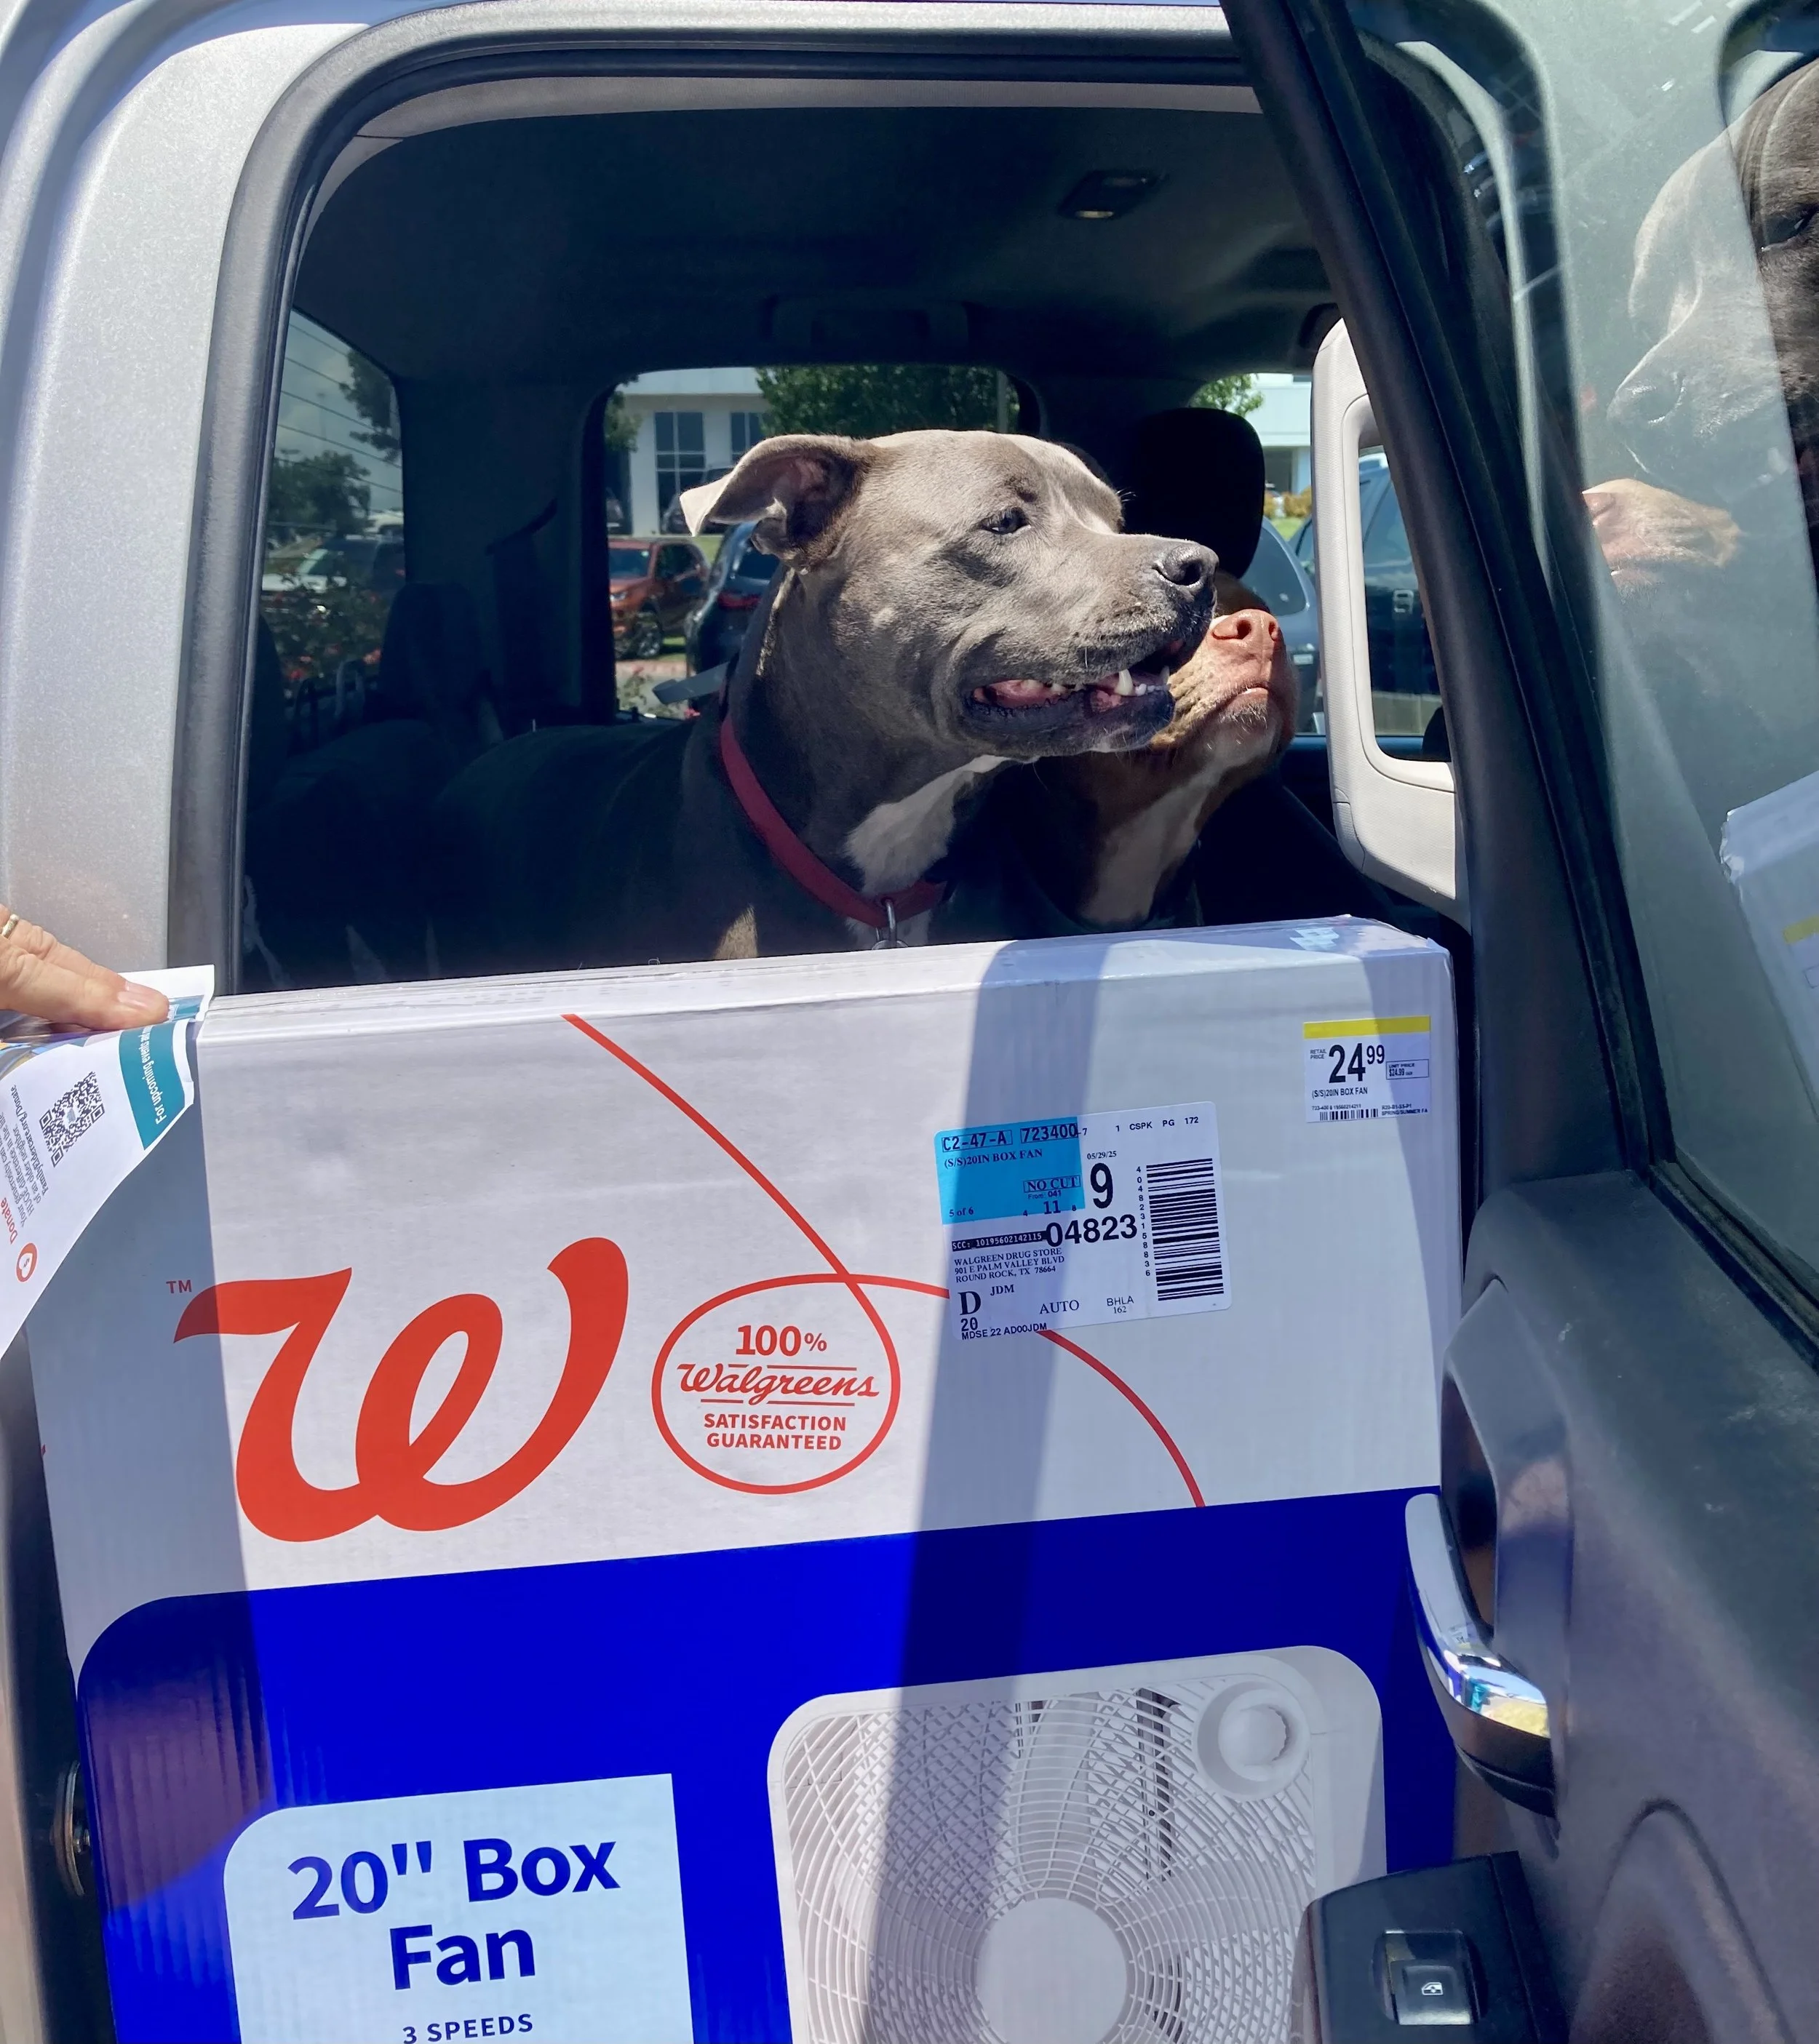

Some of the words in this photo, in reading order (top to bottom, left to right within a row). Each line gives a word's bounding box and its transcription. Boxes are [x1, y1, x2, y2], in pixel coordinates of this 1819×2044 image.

[138, 1040, 151, 1064] events
[141, 1060, 163, 1106] upcoming
[1340, 1087, 1354, 1096] BOX
[1355, 1087, 1368, 1095] FAN
[155, 1103, 167, 1125] For
[1129, 1121, 1153, 1130] CSPK
[1163, 1119, 1175, 1127] PG
[1185, 1116, 1199, 1125] 172
[10, 1084, 49, 1197] FamilyEldercare.org/Donate
[992, 1151, 1016, 1162] BOX
[1019, 1149, 1043, 1159] FAN
[1086, 1150, 1117, 1160] 05/29/25
[10, 1147, 26, 1189] difference
[24, 1161, 34, 1183] older
[4, 1160, 23, 1205] generosity
[31, 1181, 39, 1194] an
[1027, 1181, 1046, 1191] NO
[1051, 1176, 1078, 1189] CUT
[1090, 1162, 1114, 1209] 9
[22, 1186, 35, 1217] HUGE
[33, 1192, 41, 1204] of
[1043, 1199, 1062, 1215] 11
[1, 1197, 18, 1245] Donate
[18, 1203, 28, 1228] Your
[949, 1209, 955, 1217] 5
[957, 1207, 966, 1216] of
[968, 1206, 974, 1215] 6
[1046, 1214, 1138, 1247] 04823
[952, 1240, 971, 1250] SCC:
[954, 1253, 1005, 1266] WALGREEN
[1006, 1250, 1031, 1261] DRUG
[1032, 1247, 1062, 1257] STORE
[955, 1267, 967, 1275] 901
[976, 1262, 1003, 1272] PALM
[1004, 1258, 1039, 1269] VALLEY
[1041, 1255, 1065, 1265] BLVD
[955, 1273, 987, 1283] ROUND
[989, 1270, 1016, 1279] ROCK,
[1035, 1266, 1056, 1274] 78664
[166, 1280, 192, 1294] TM
[990, 1284, 1015, 1296] JDM
[958, 1290, 982, 1316] D
[1039, 1299, 1080, 1314] AUTO
[1107, 1295, 1134, 1306] BHLA
[1113, 1306, 1127, 1314] 162
[960, 1317, 978, 1332] 20
[735, 1325, 827, 1357] 100%
[961, 1329, 988, 1341] MDSE
[990, 1328, 1001, 1337] 22
[677, 1362, 880, 1405] Walgreens
[704, 1413, 846, 1432] SATISFACTION
[706, 1432, 842, 1450] GUARANTEED
[463, 1837, 621, 1902] Box
[389, 1924, 536, 1990] Fan
[402, 2026, 418, 2044] 3
[426, 2013, 533, 2043] SPEEDS
